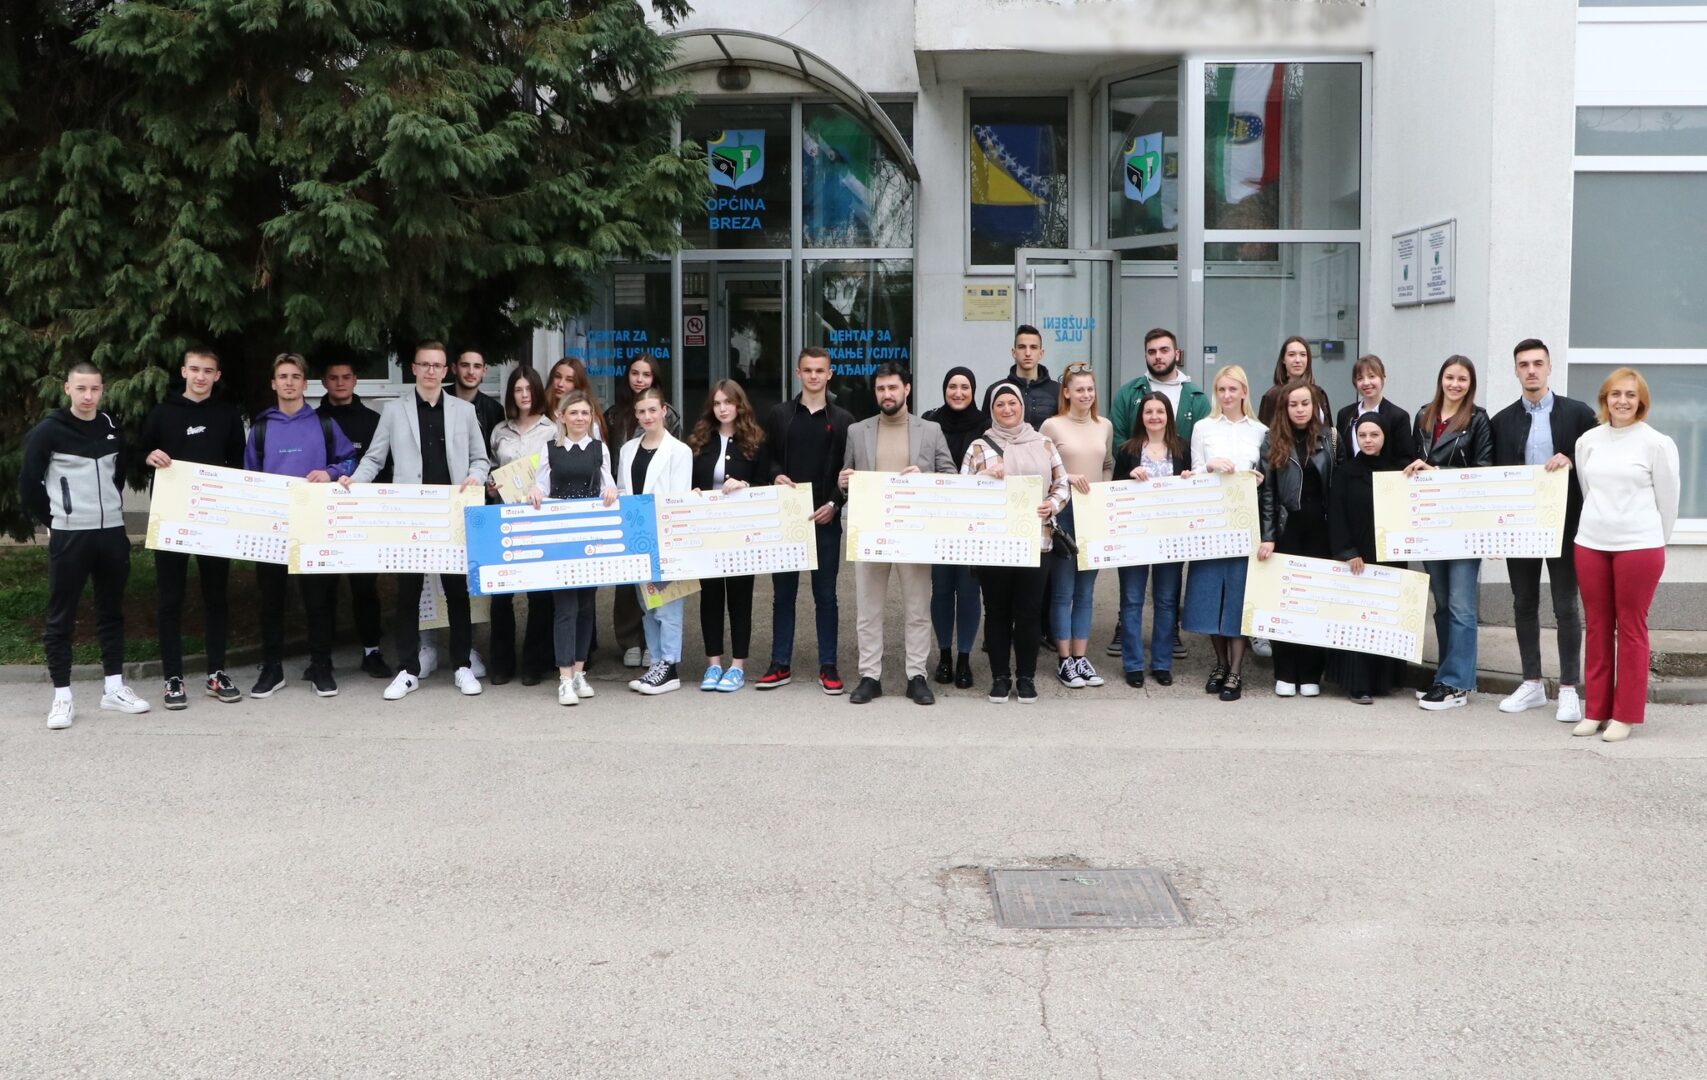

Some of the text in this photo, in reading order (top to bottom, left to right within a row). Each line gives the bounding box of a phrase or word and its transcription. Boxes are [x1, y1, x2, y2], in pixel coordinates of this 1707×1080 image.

[706, 194, 766, 211] OPĆINA
[709, 216, 762, 230] BREZA
[588, 330, 648, 342] CENTAR ZA
[830, 330, 892, 343] ЦЕНТАР ЗА
[825, 347, 908, 358] ЖАЊЕ УСЛУГА
